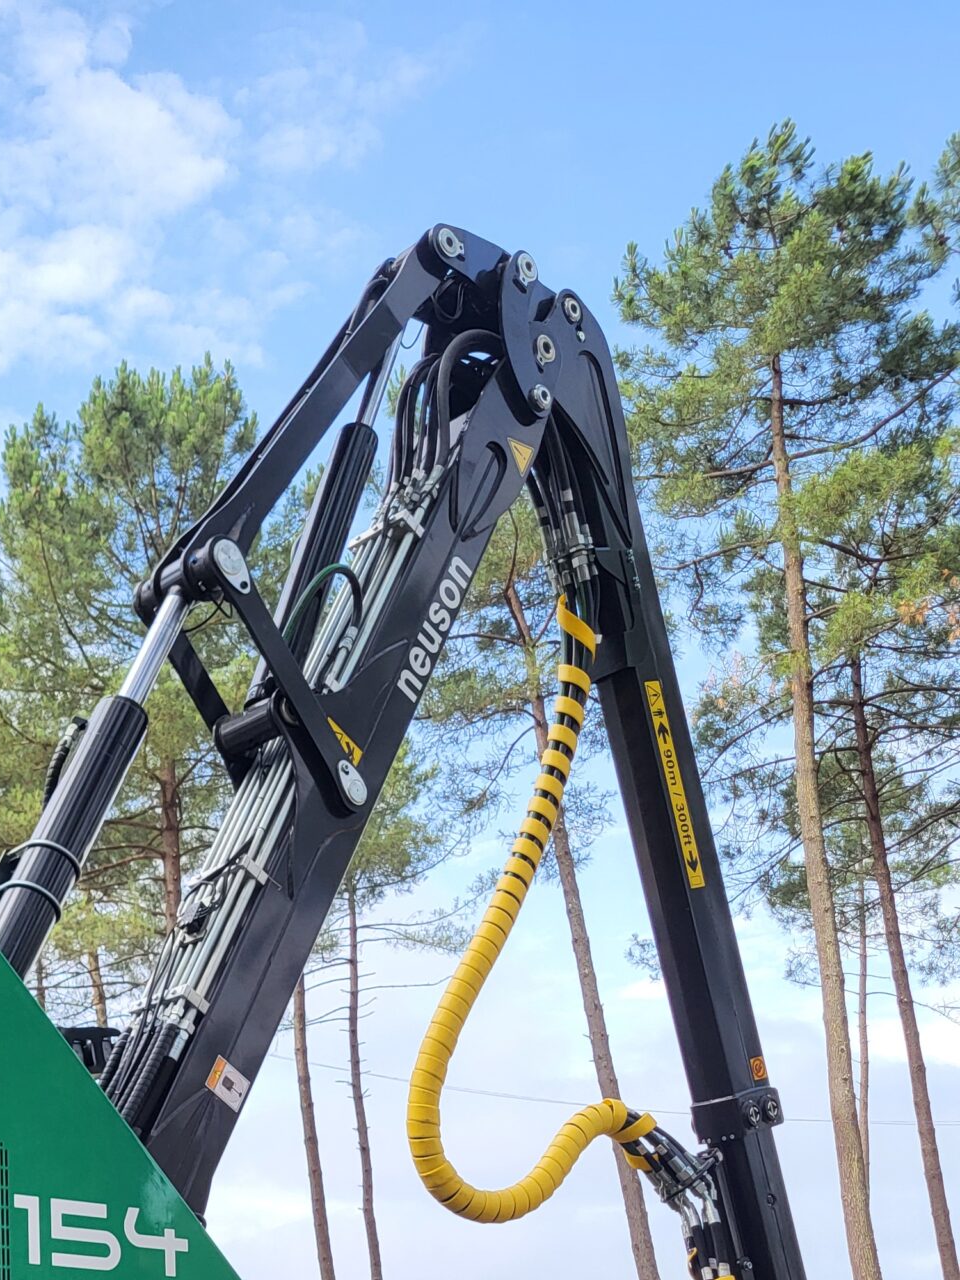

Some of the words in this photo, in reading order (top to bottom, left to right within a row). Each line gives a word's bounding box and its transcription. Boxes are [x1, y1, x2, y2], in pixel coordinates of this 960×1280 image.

[397, 556, 473, 703] neuson
[663, 749, 677, 786] 90m
[675, 803, 693, 846] 300ft
[13, 1193, 189, 1277] 154
